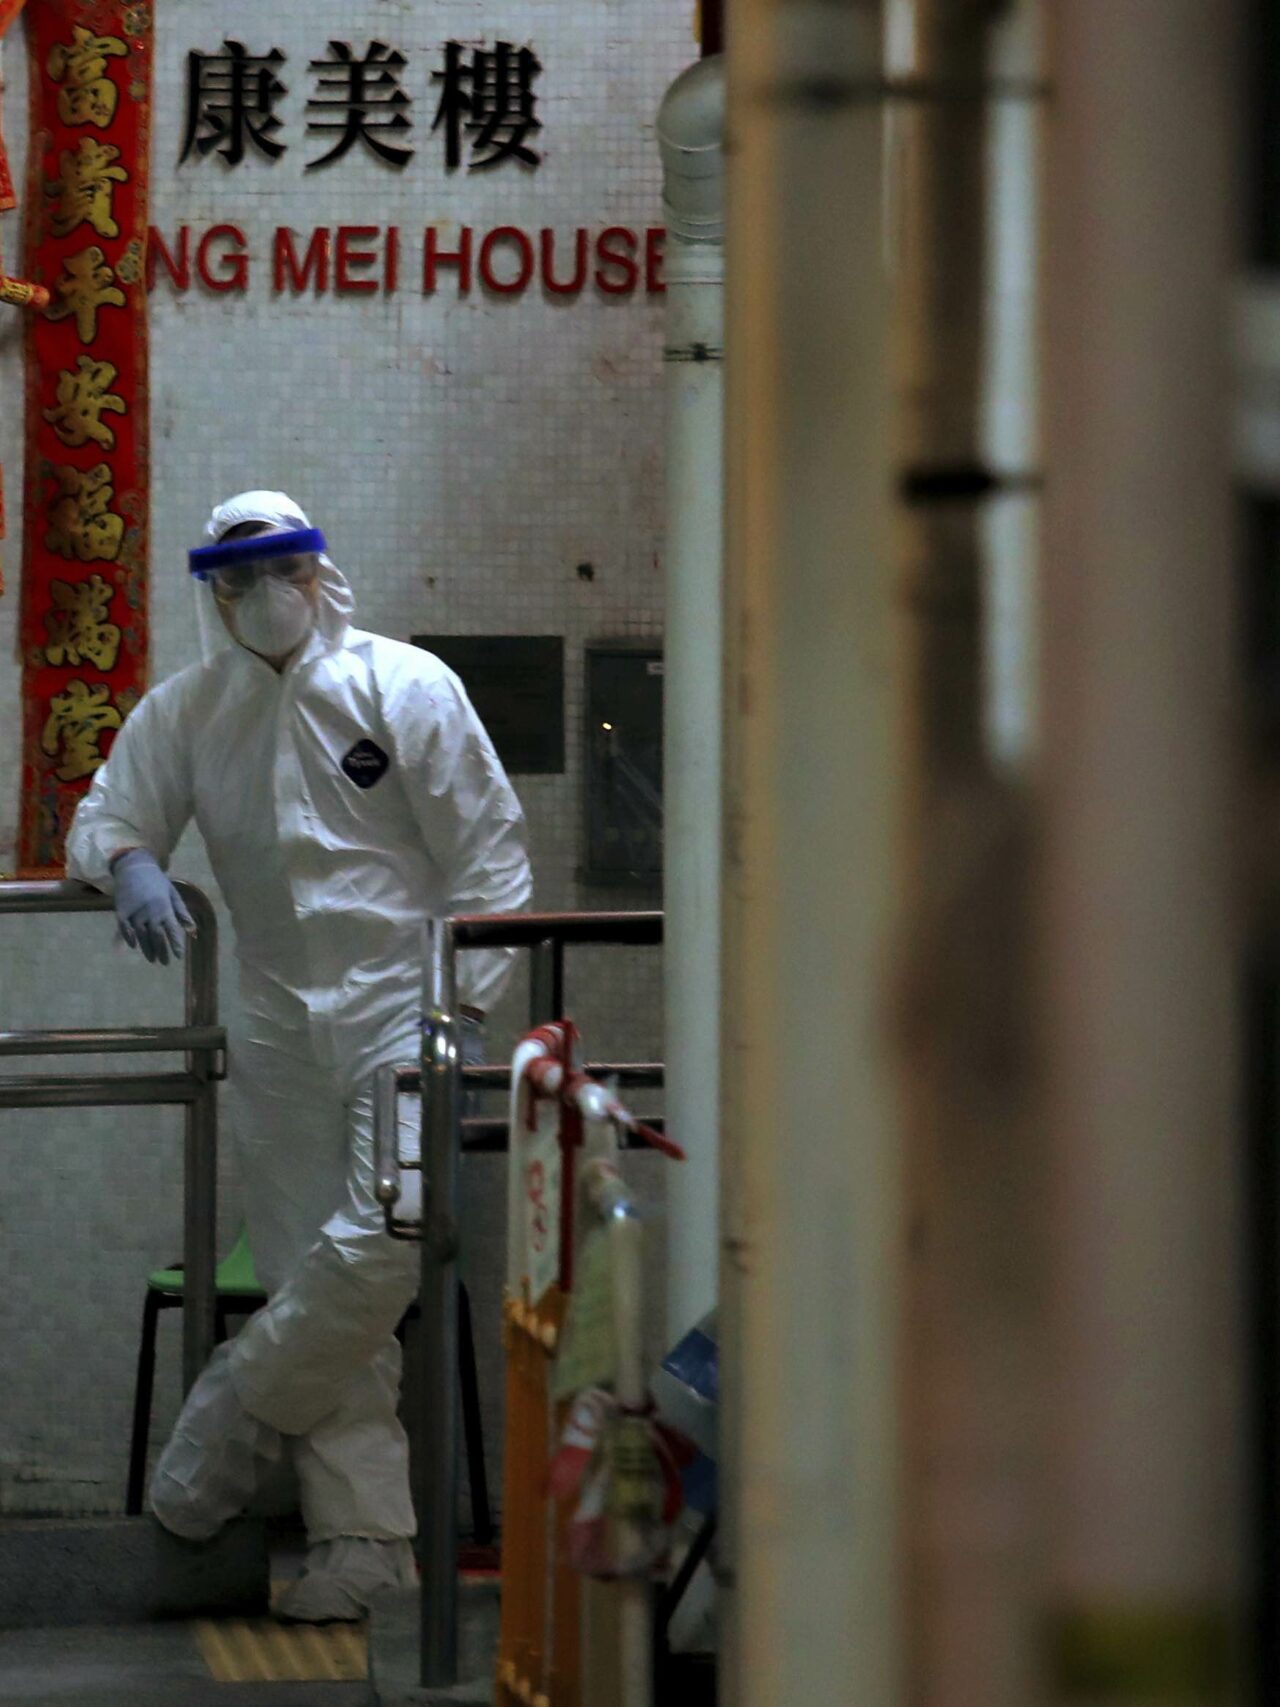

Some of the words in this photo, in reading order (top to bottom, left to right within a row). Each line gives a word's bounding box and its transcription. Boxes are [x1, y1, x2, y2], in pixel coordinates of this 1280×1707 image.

[179, 40, 543, 171] 康美樓
[146, 225, 248, 292] NG
[273, 225, 398, 293] MEI
